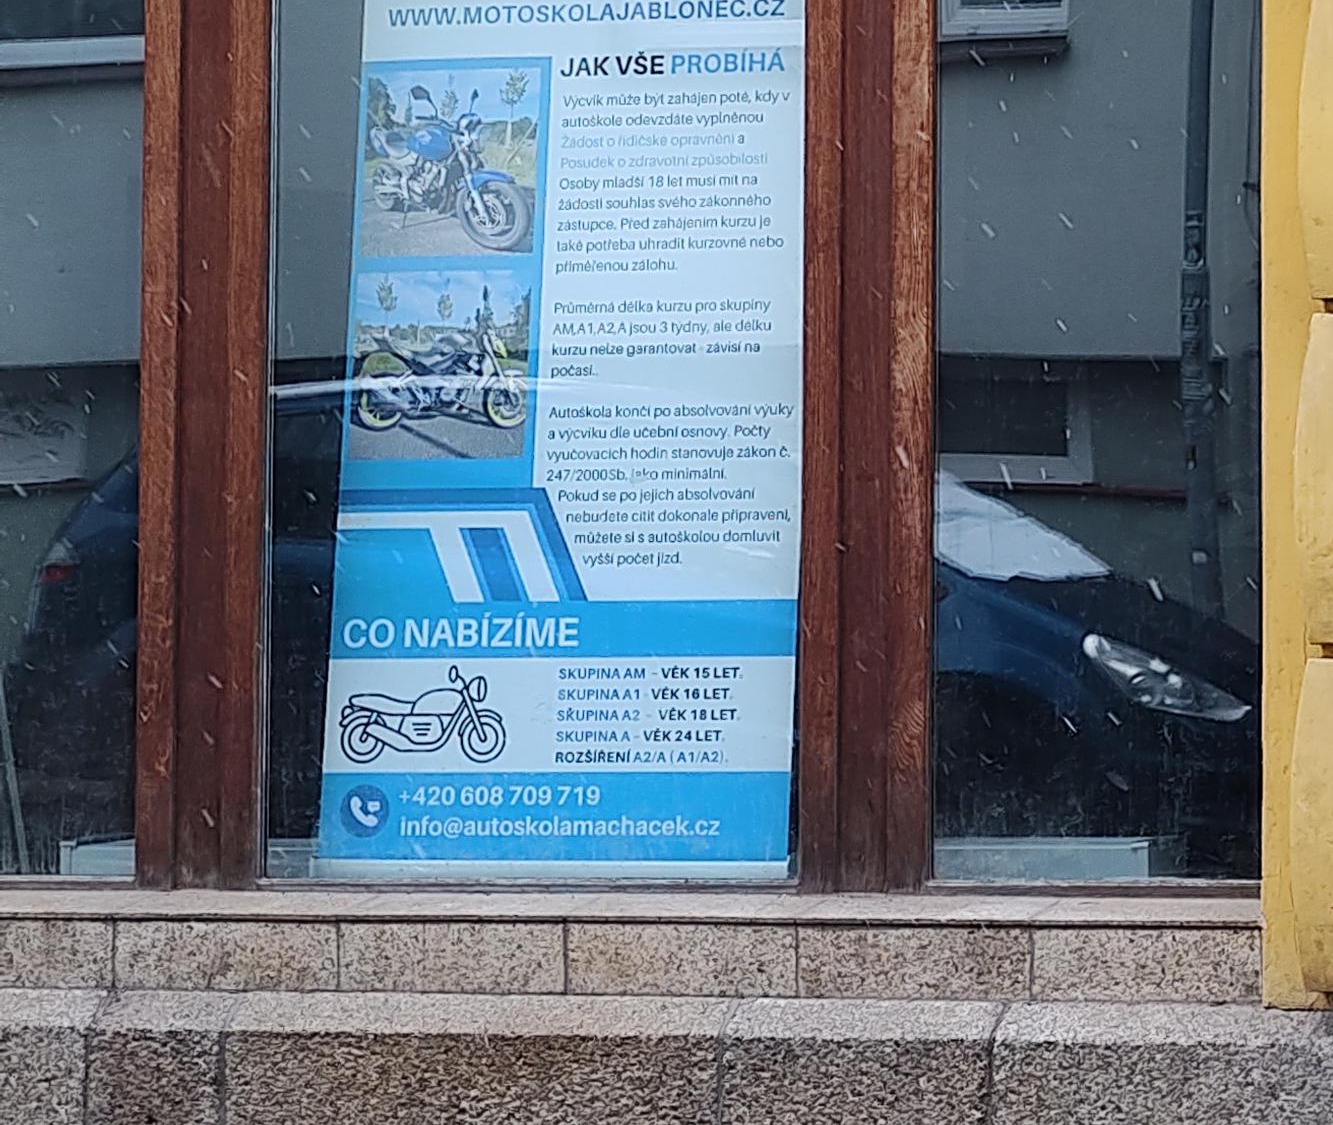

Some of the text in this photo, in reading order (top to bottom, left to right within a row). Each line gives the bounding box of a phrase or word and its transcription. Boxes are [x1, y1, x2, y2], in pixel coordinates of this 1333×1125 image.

[560, 48, 785, 77] JAK VŠE PROBÍHÁ
[342, 613, 580, 649] CO NABÍZÍME
[558, 668, 620, 680] SKUPINA
[623, 668, 645, 679] AM
[661, 667, 689, 678] VĚK
[694, 667, 710, 678] 15
[558, 689, 619, 700] SKUPINA
[622, 689, 640, 700] A1
[652, 687, 680, 699] VĚK
[684, 688, 700, 699] 16
[557, 709, 618, 721] SKUPINA
[622, 710, 640, 721] A2
[659, 708, 686, 720] VĚK
[691, 709, 707, 720] 18
[556, 730, 618, 742] SKUPINA
[620, 731, 630, 742] A
[643, 729, 672, 741] VĚK
[675, 730, 692, 741] 24
[555, 749, 631, 763] ROZŠÍŘENÍ
[633, 751, 666, 763] A2/A
[398, 786, 601, 808] +420 608 709 719
[399, 816, 720, 838] info@autoskolamachacek.cz
